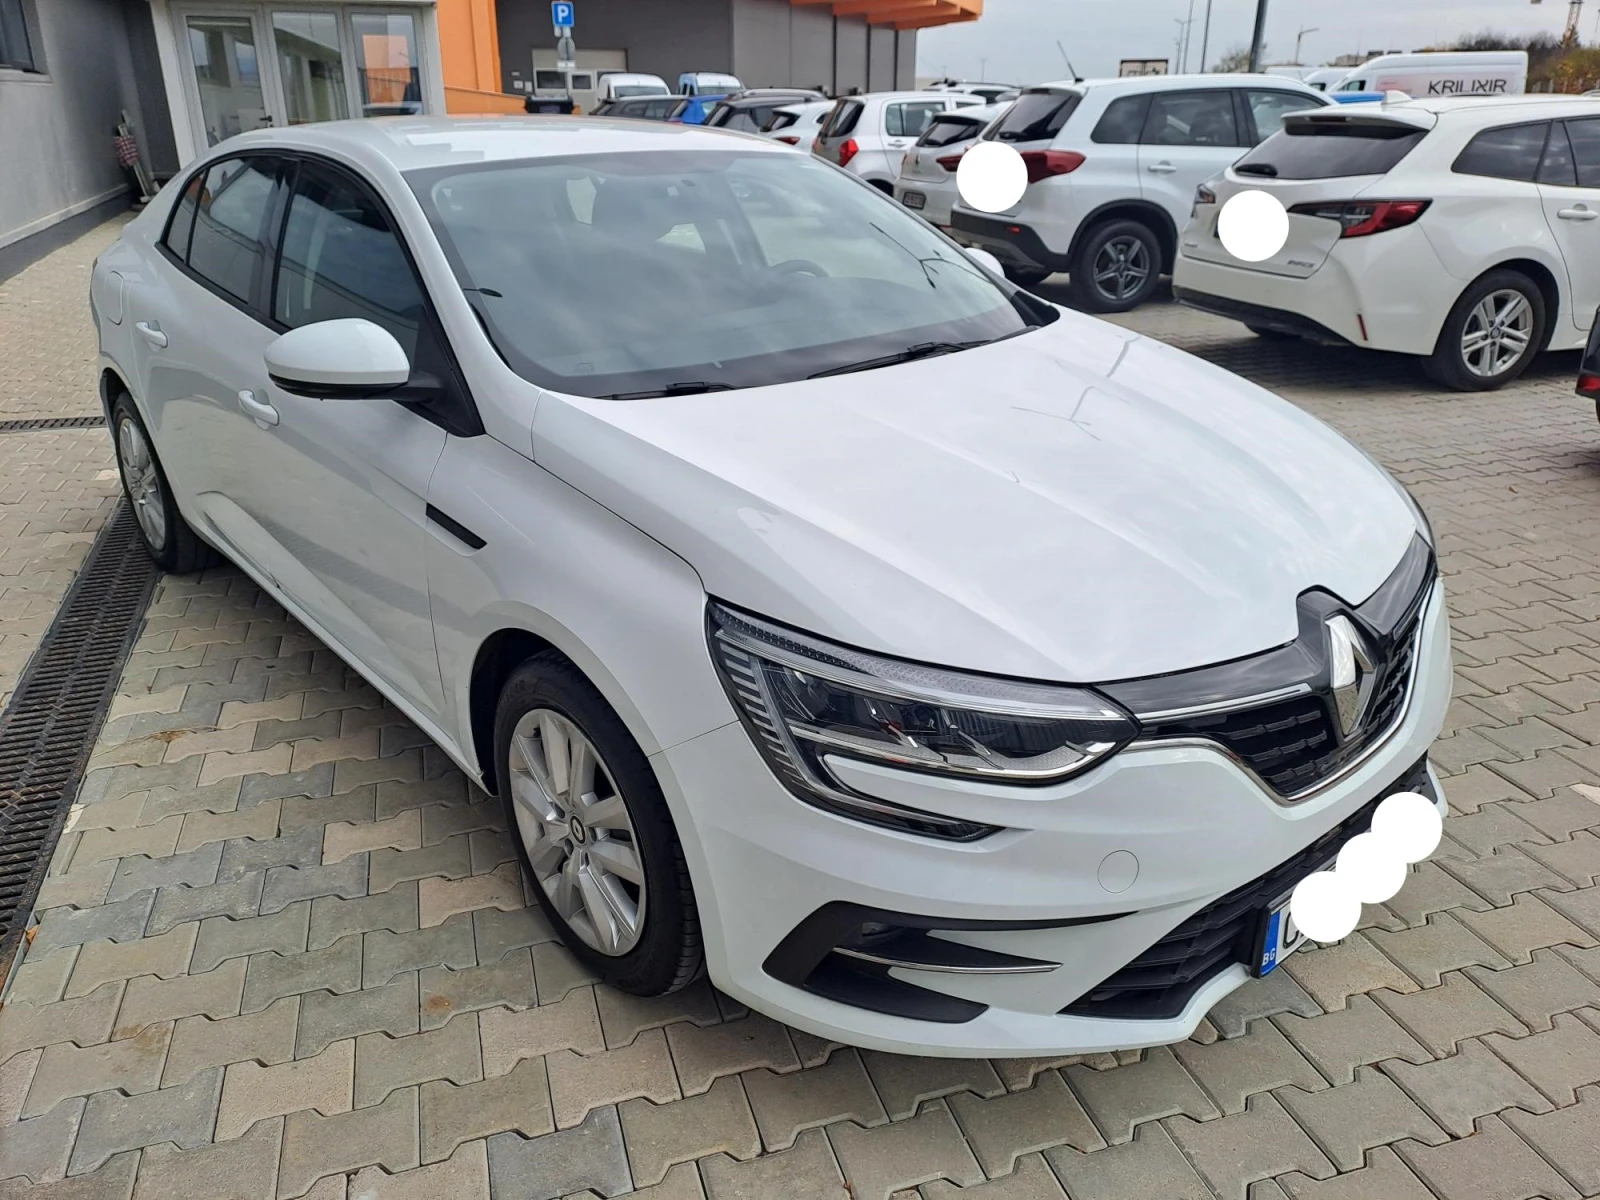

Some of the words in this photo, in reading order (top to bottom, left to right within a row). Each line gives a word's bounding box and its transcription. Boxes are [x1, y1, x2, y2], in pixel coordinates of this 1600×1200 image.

[557, 4, 569, 23] P
[1427, 79, 1507, 95] KRILIXIR
[1261, 947, 1276, 967] BG
